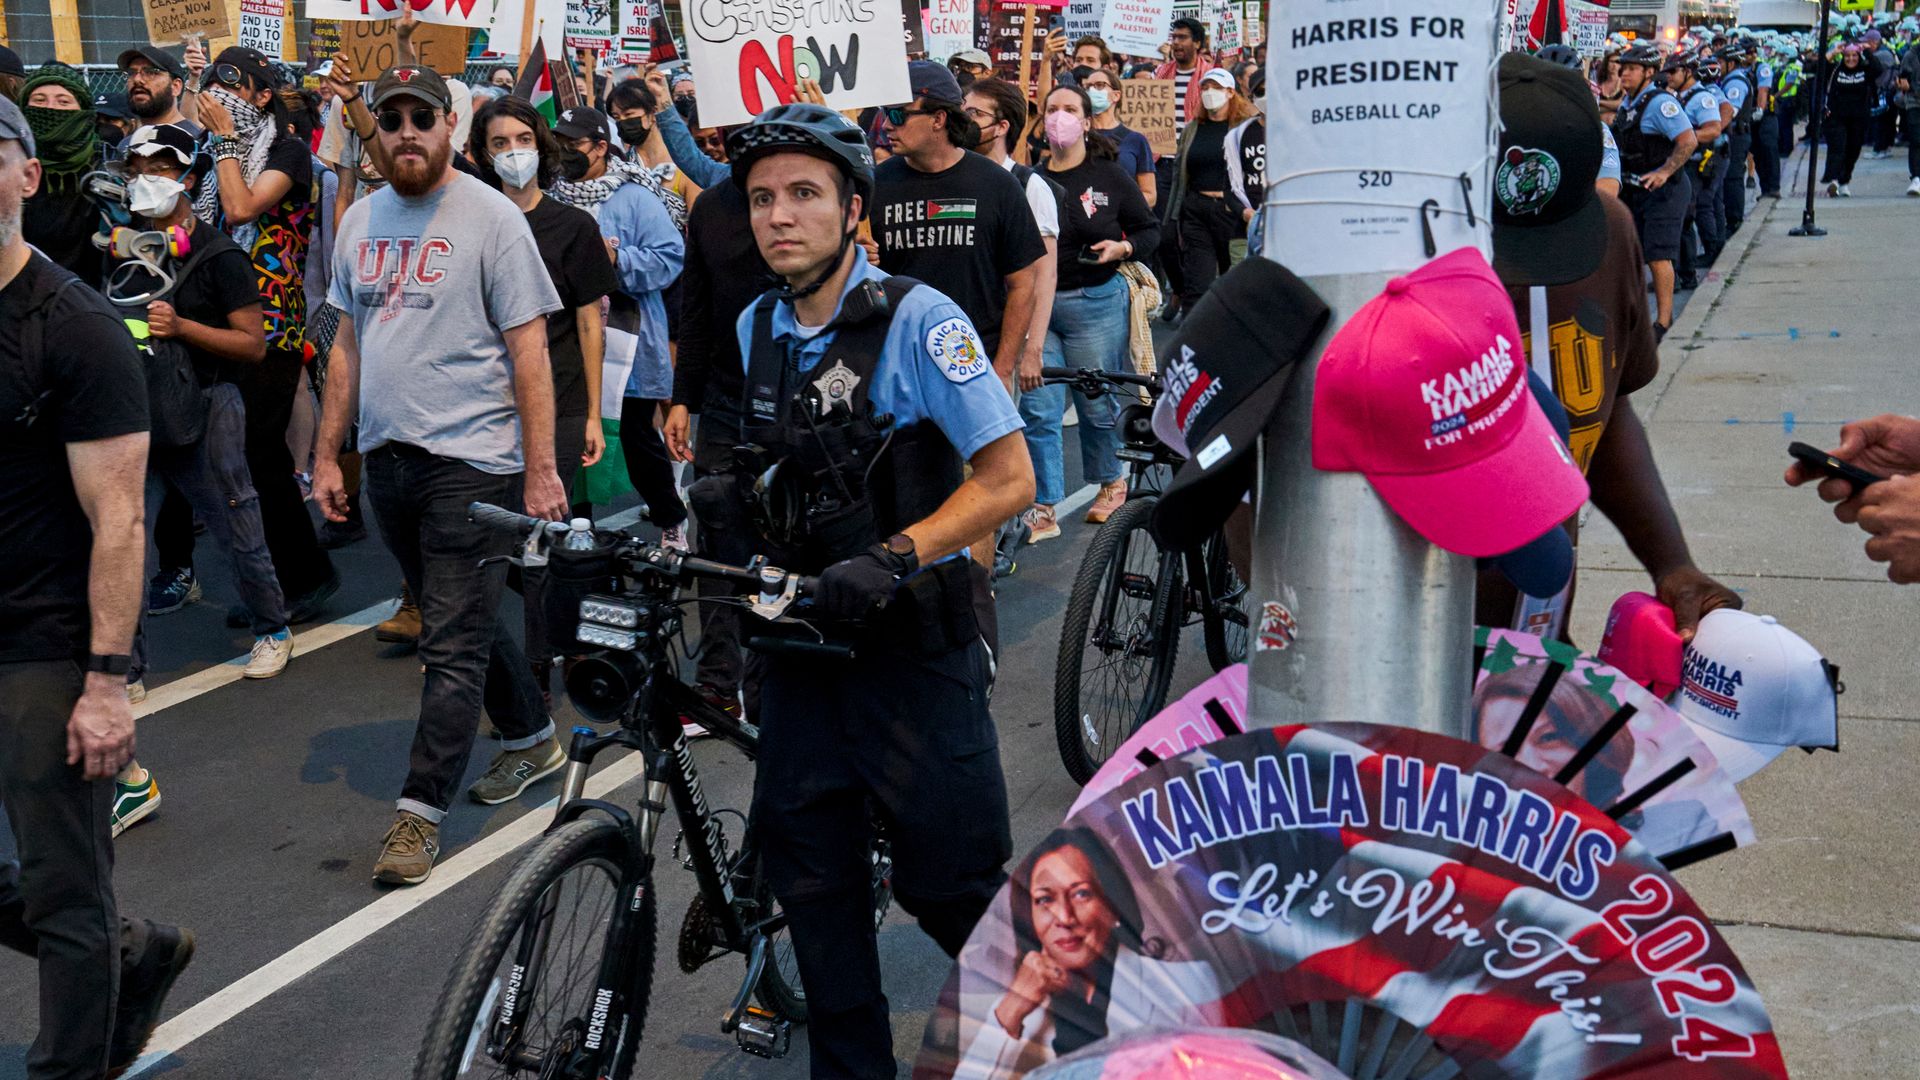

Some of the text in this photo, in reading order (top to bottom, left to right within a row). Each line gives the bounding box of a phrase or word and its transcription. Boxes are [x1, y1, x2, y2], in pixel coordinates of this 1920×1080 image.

[185, 1, 211, 15] NOW
[242, 3, 283, 15] PALESTINE!
[567, 3, 579, 11] THE
[1070, 4, 1093, 14] FIGHT
[1115, 3, 1162, 15] CLASS WAR
[154, 14, 187, 29] ARMS
[162, 18, 216, 34] EMBARGO
[243, 15, 261, 26] END
[636, 17, 647, 26] TO
[1113, 23, 1158, 34] PALESTINE!
[1135, 16, 1152, 24] FREE
[241, 26, 280, 41] AID TO
[1292, 16, 1399, 49] HARRIS
[1410, 16, 1464, 40] FOR
[241, 38, 280, 53] ISRAEL!
[353, 40, 436, 74] VOE
[739, 33, 859, 116] NOW
[1296, 60, 1458, 90] PRESIDENT
[1141, 116, 1174, 128] END
[1312, 103, 1441, 124] BASEBALL CAP
[1358, 170, 1393, 189] $20
[884, 201, 925, 225] FREE
[885, 225, 976, 251] PALESTINE
[356, 236, 454, 286] UIC
[934, 322, 975, 357] CHICAGO
[948, 352, 984, 376] POLICE
[1421, 334, 1511, 404] KAMALA
[1431, 413, 1467, 435] 2024
[1424, 430, 1462, 450] FOR
[1686, 645, 1743, 686] KAMALA
[1682, 659, 1736, 697] HARRIS
[673, 730, 729, 886] CHICAGO POLICE
[1121, 752, 1755, 1061] KAMALA HARRIS 2024
[1200, 863, 1642, 1045] Let's Win This!
[500, 964, 525, 1025] ROCKSHOX
[584, 988, 613, 1050] ROCKSHOX
